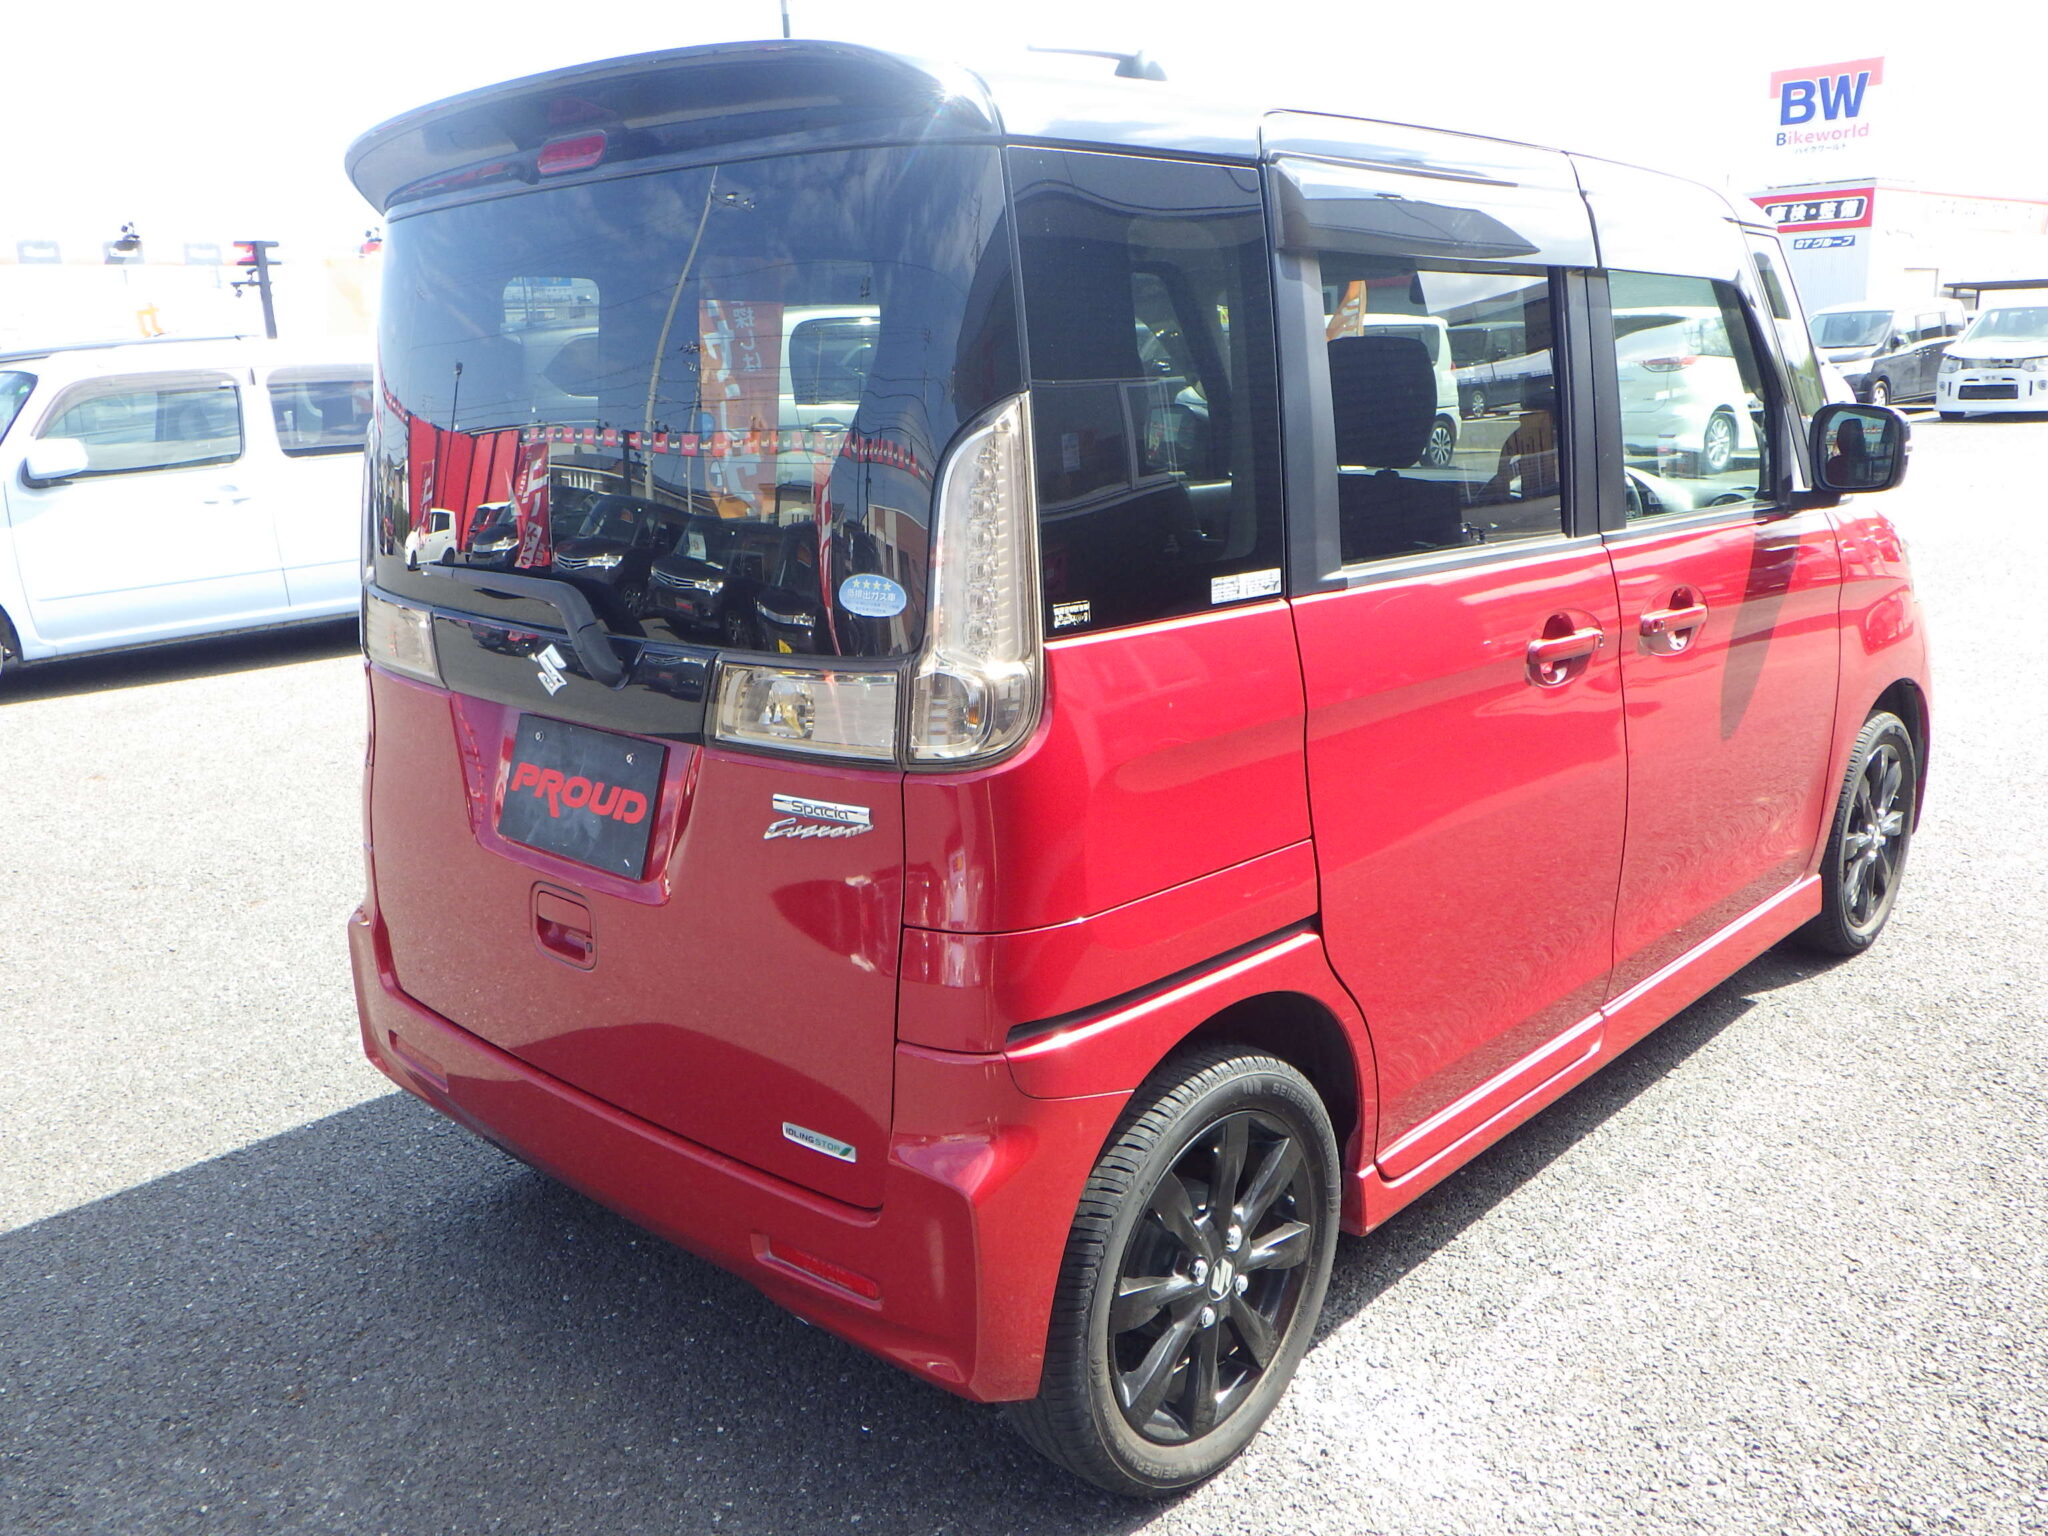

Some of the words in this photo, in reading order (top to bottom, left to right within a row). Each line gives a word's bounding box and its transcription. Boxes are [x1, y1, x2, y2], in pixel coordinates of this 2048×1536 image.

[1780, 71, 1870, 126] BW
[1776, 122, 1869, 147] Bikeworld
[510, 762, 648, 825] PROUD
[791, 800, 849, 820] Spacia
[763, 817, 874, 840] Custom
